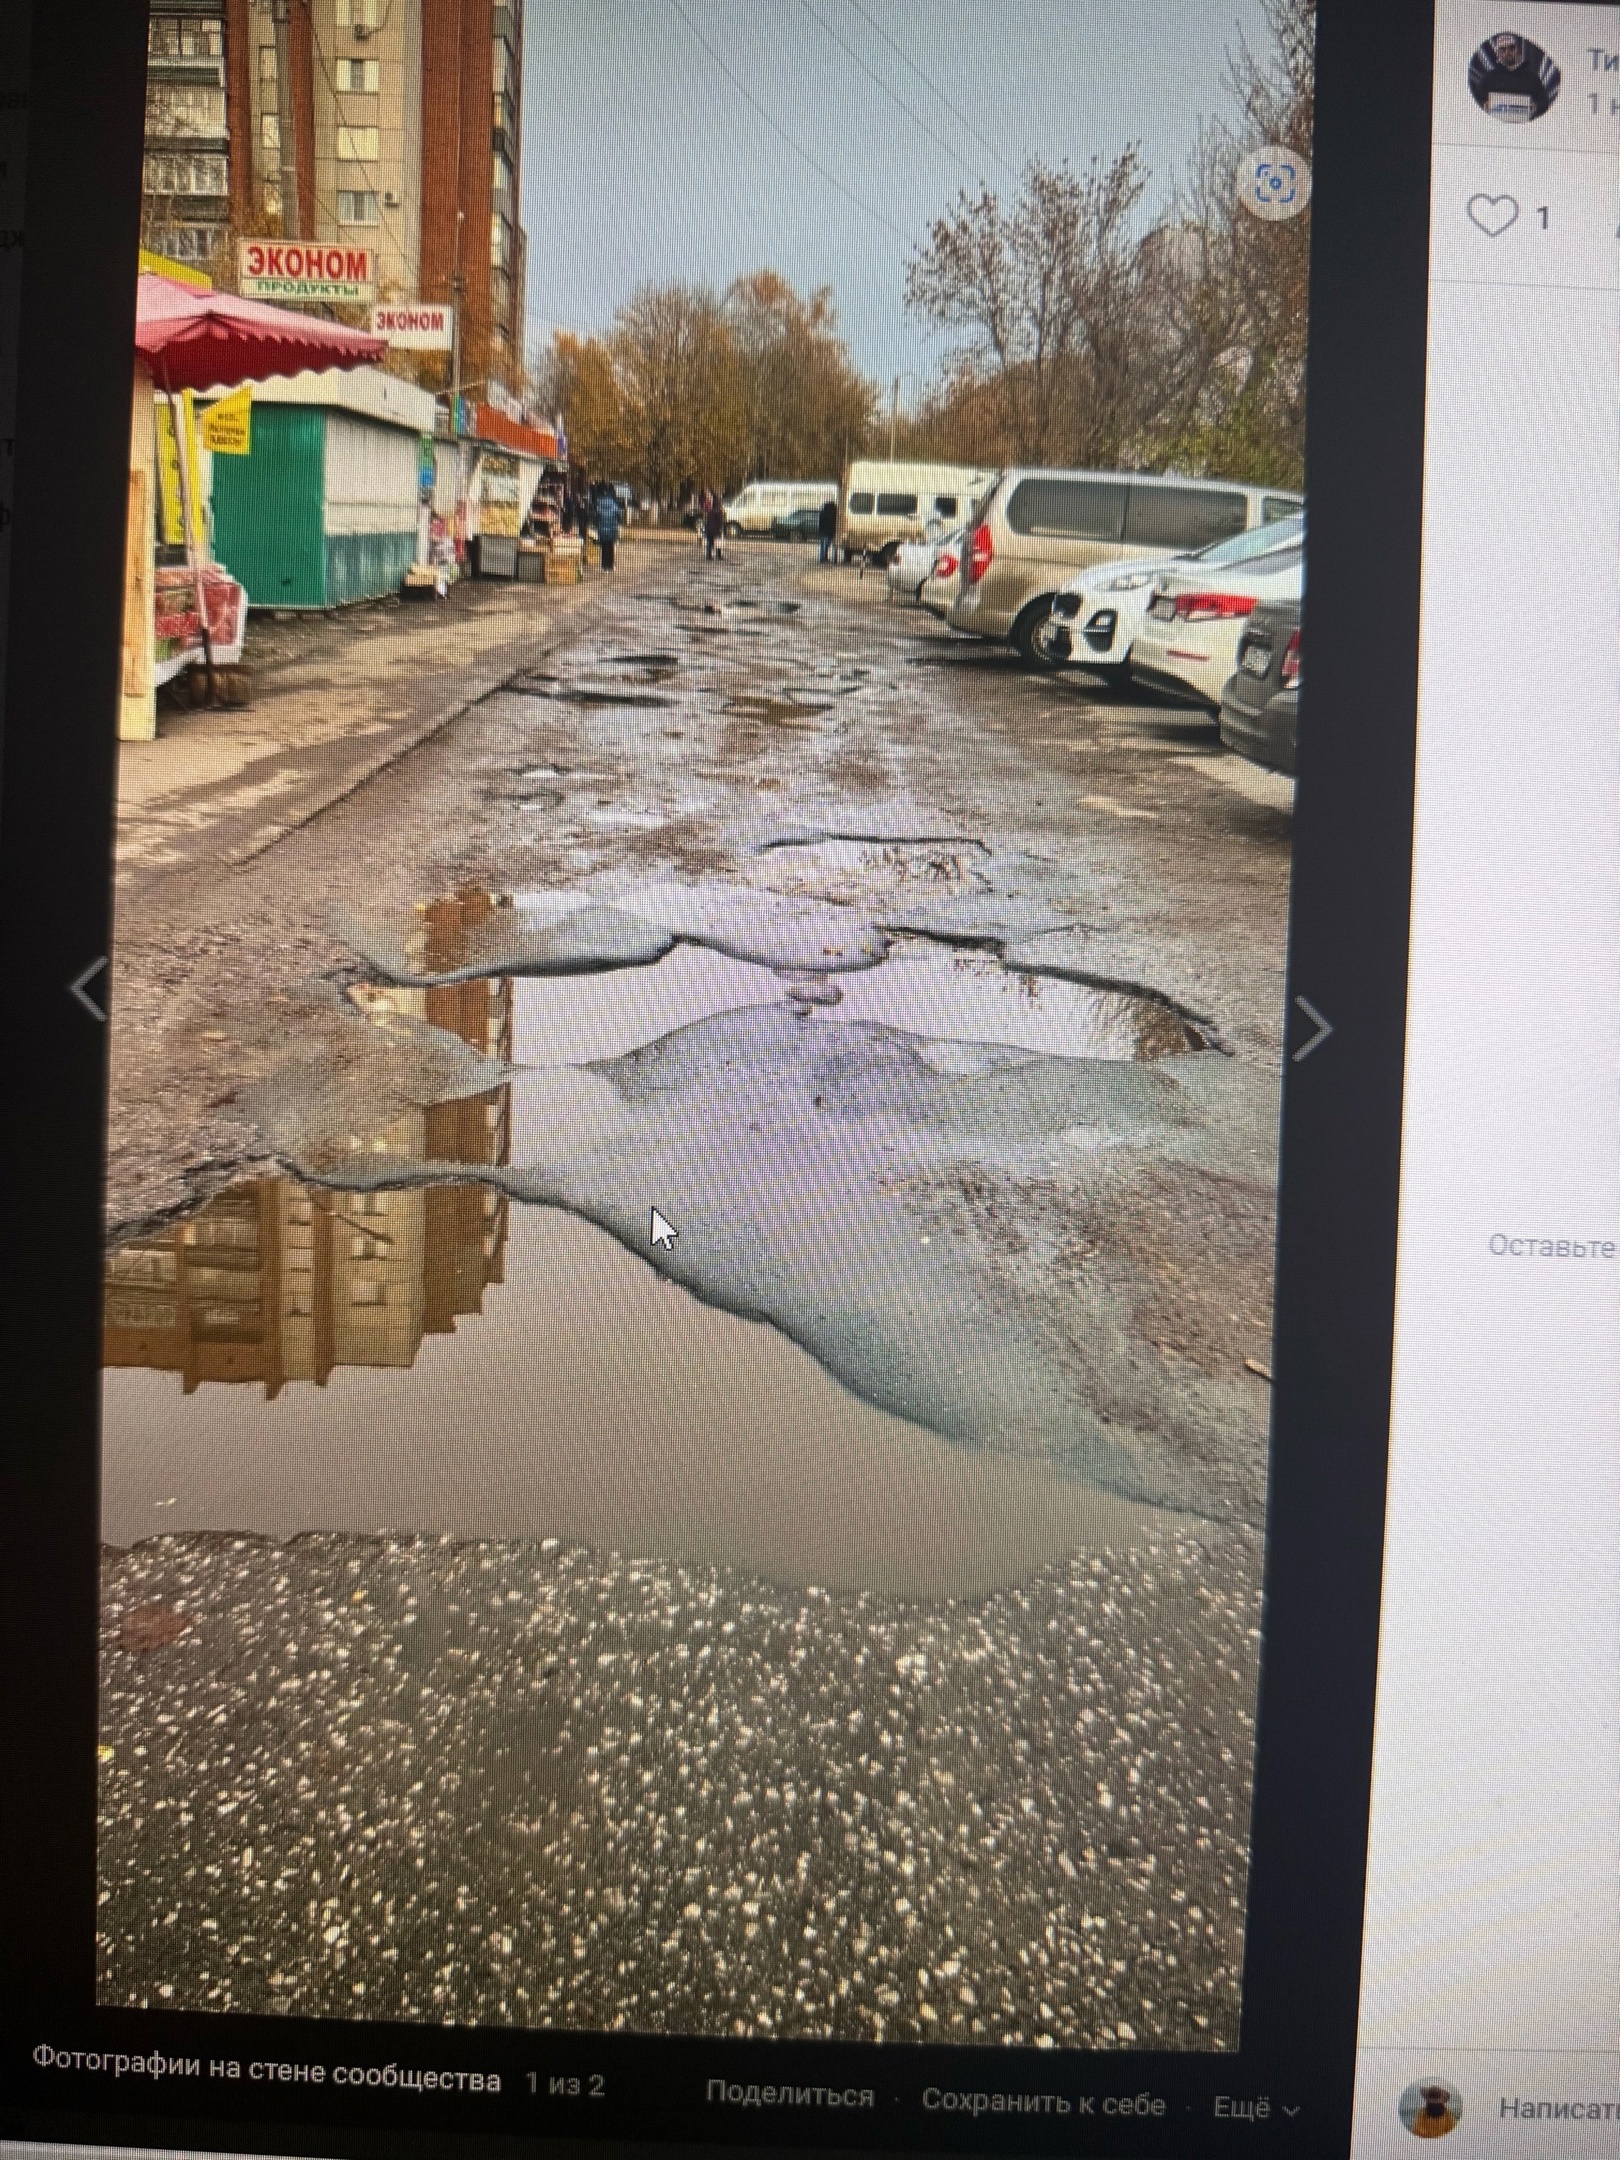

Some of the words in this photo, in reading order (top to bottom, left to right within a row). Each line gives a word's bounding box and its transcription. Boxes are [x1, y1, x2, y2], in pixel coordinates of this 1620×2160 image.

[1536, 206, 1549, 230] 1
[248, 246, 366, 280] ЭКОНОМ
[257, 281, 358, 296] ПРОДУКТЫ
[377, 312, 444, 331] ЭКОНОМ
[1489, 1233, 1615, 1259] Оставьте
[33, 2044, 201, 2081] Фотографии
[210, 2057, 241, 2079] на
[249, 2060, 326, 2084] стене
[332, 2063, 502, 2093] сообщества
[526, 2071, 539, 2094] 1
[549, 2076, 582, 2096] из
[589, 2074, 606, 2097] 2
[706, 2078, 875, 2109] Поделиться
[922, 2086, 1072, 2118] Сохранить
[1080, 2096, 1095, 2115] к
[1102, 2091, 1167, 2116] себе
[1214, 2095, 1272, 2123] Ещё
